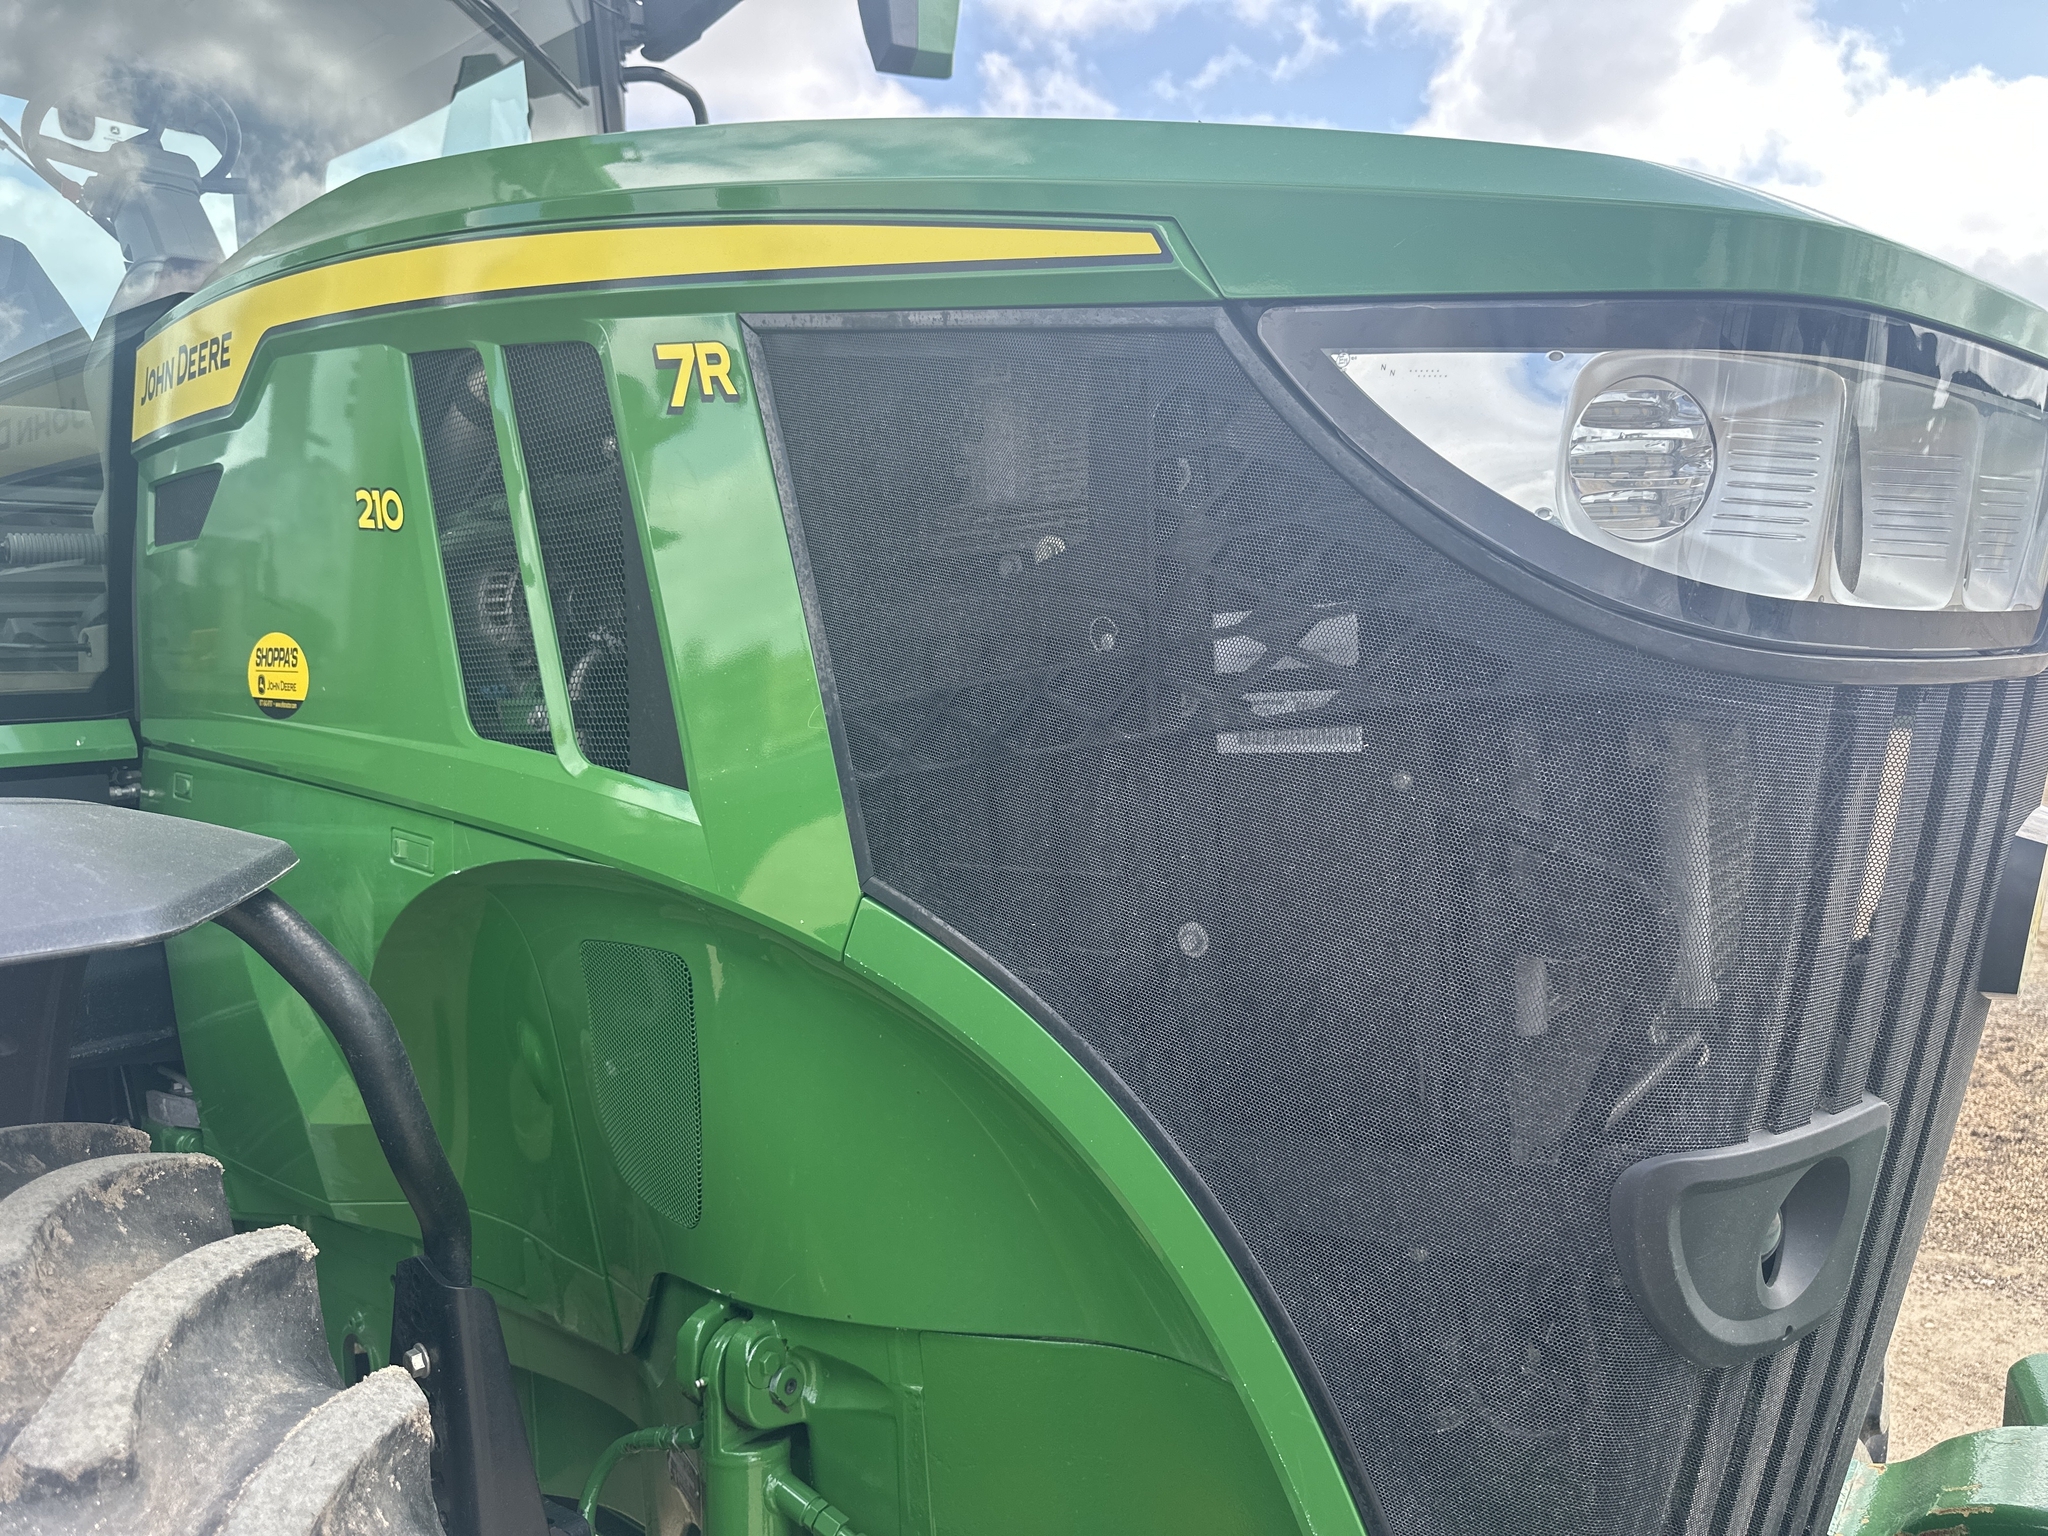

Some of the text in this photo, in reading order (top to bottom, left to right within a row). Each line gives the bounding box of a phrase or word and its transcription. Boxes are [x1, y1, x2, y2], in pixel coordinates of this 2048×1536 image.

[140, 331, 233, 406] JOHN DEERE
[652, 340, 741, 415] 7R
[355, 486, 405, 533] 210
[255, 647, 299, 668] SHOPPA'S
[267, 680, 297, 692] JOHN DEERE
